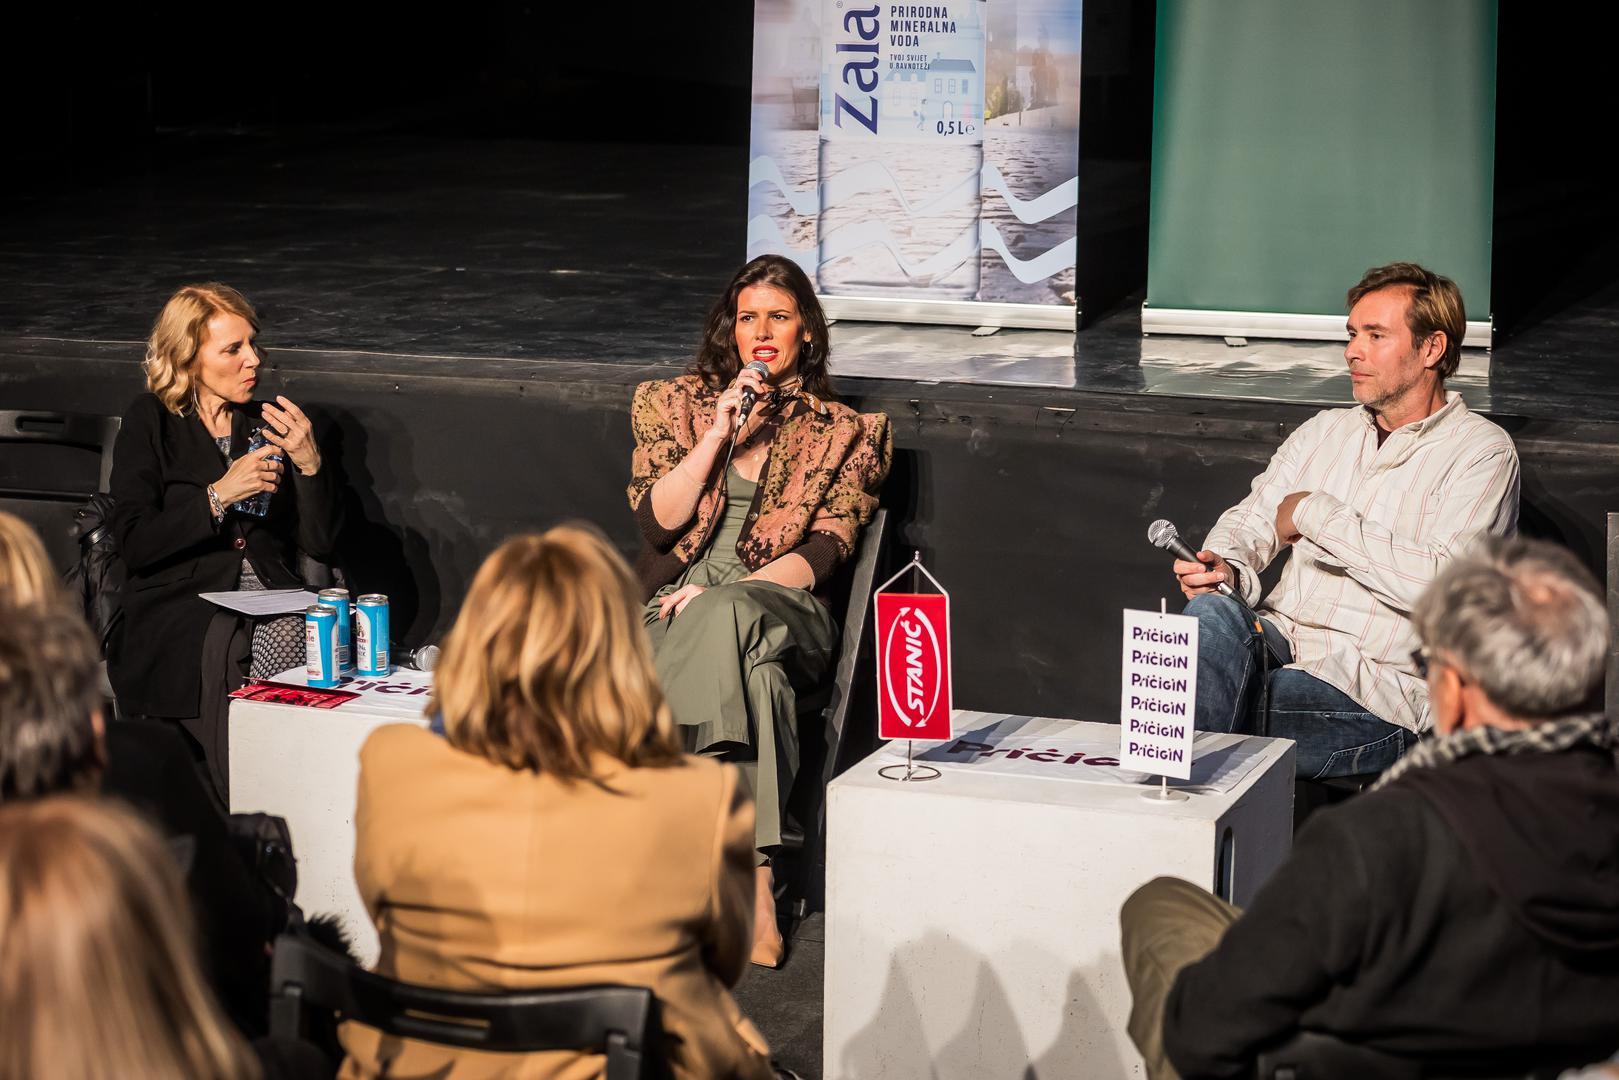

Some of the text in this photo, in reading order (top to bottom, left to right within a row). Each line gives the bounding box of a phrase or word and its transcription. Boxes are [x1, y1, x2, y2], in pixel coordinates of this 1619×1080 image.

[890, 5, 948, 18] PRIRODNA
[890, 20, 957, 33] MINERALNA
[890, 35, 920, 47] VODA
[890, 54, 928, 62] TVOJ SVIJET
[834, 4, 881, 135] Zala
[936, 120, 955, 136] 0,5
[900, 619, 925, 717] STANIĆ
